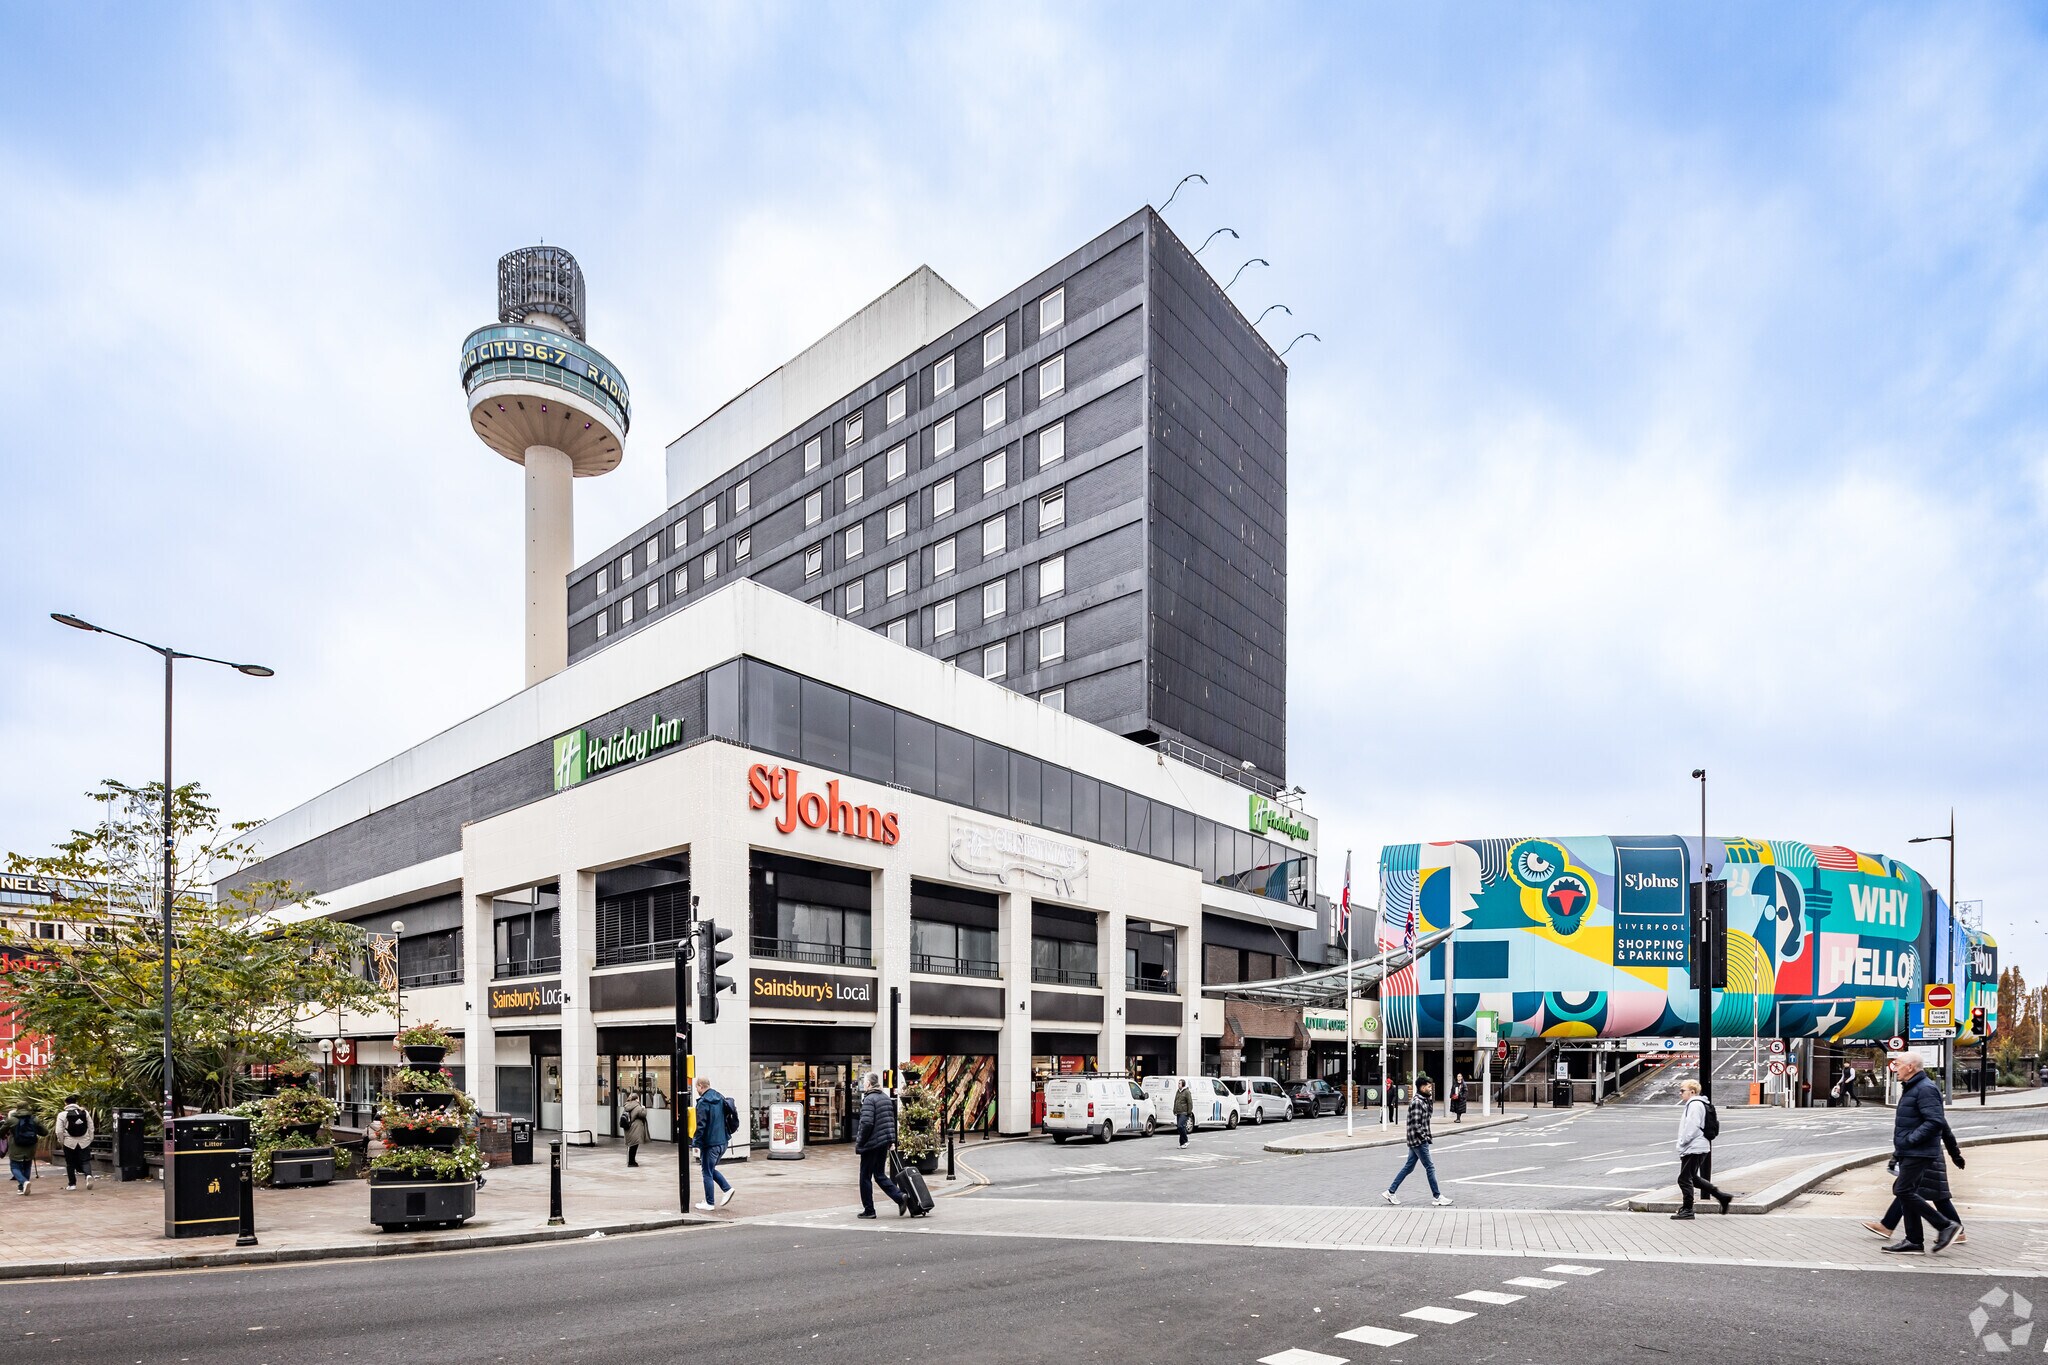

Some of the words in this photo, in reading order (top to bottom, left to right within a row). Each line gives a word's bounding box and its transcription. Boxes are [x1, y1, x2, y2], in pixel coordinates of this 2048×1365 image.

[480, 342, 517, 359] CITY
[588, 364, 628, 408] RADIO
[586, 726, 652, 773] Holiday
[650, 713, 684, 750] Inn
[1848, 883, 1909, 928] WHY
[1618, 923, 1685, 931] LIVERPOOL
[1618, 939, 1684, 950] SHOPPING
[1618, 950, 1625, 960] &
[1629, 950, 1684, 961] PARKING
[1975, 951, 1993, 977] YOU
[493, 986, 541, 1011] Sainsbury's
[541, 986, 562, 1006] Loca
[754, 977, 833, 1002] Sainsbury's
[836, 982, 870, 1001] Local
[1774, 1043, 1780, 1051] 5
[1893, 1040, 1899, 1048] 5
